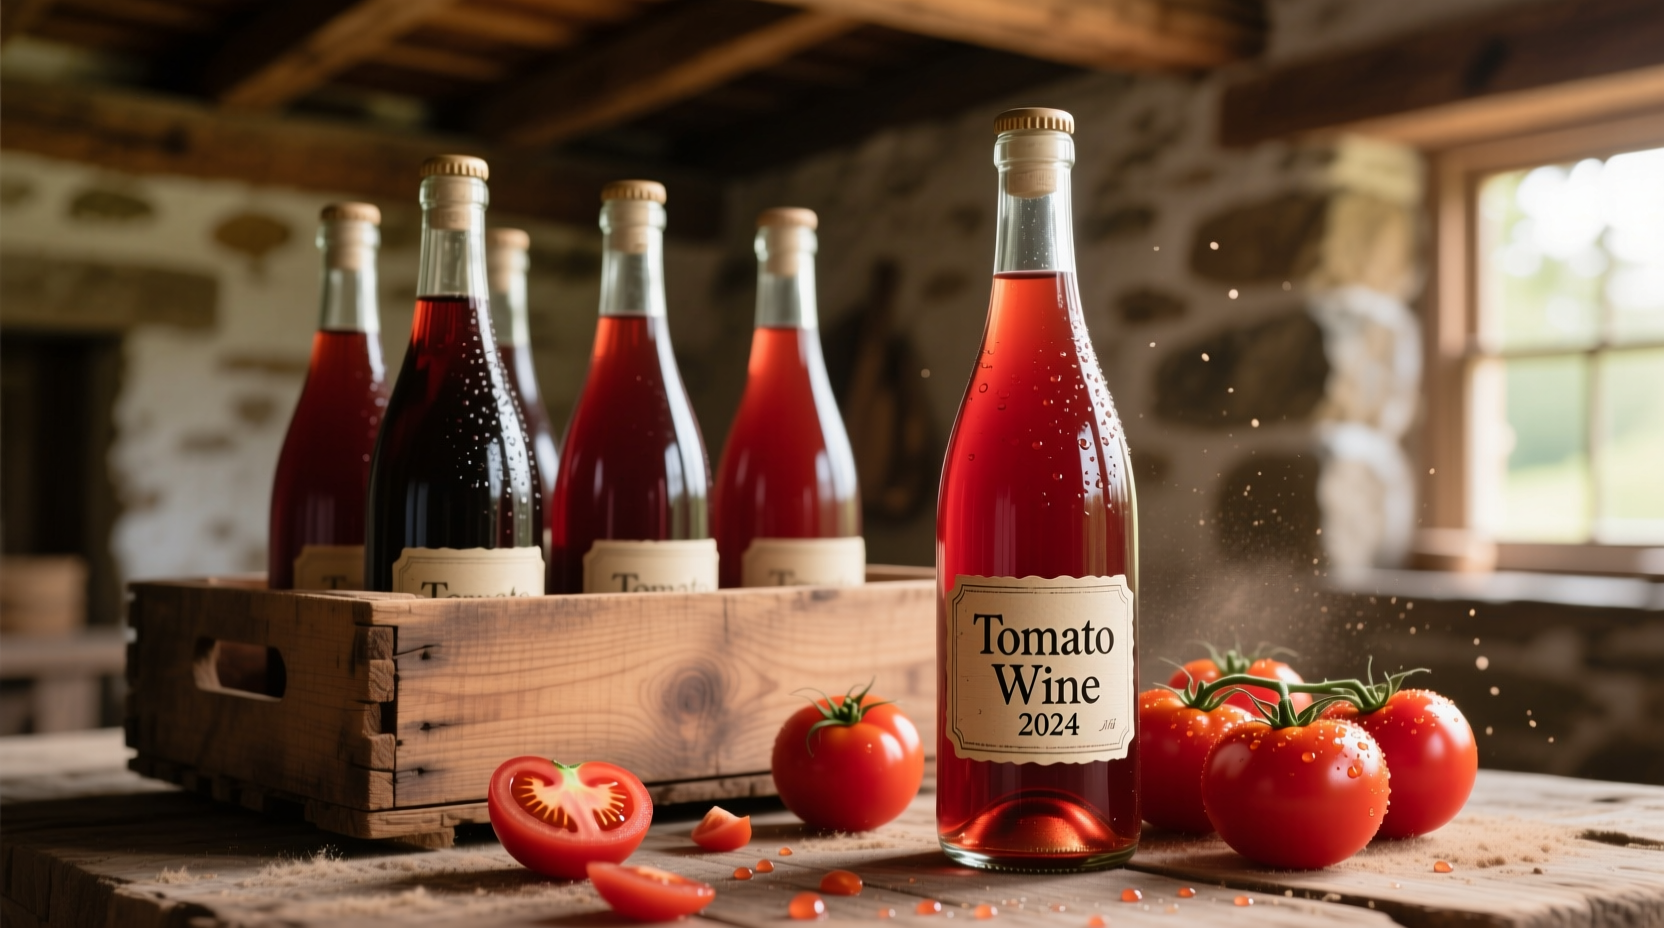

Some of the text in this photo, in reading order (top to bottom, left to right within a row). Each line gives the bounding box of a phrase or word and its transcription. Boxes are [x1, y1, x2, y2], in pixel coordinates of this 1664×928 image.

[973, 613, 1115, 656] Tomato
[991, 663, 1101, 705] Wine
[1018, 712, 1080, 736] 2024
